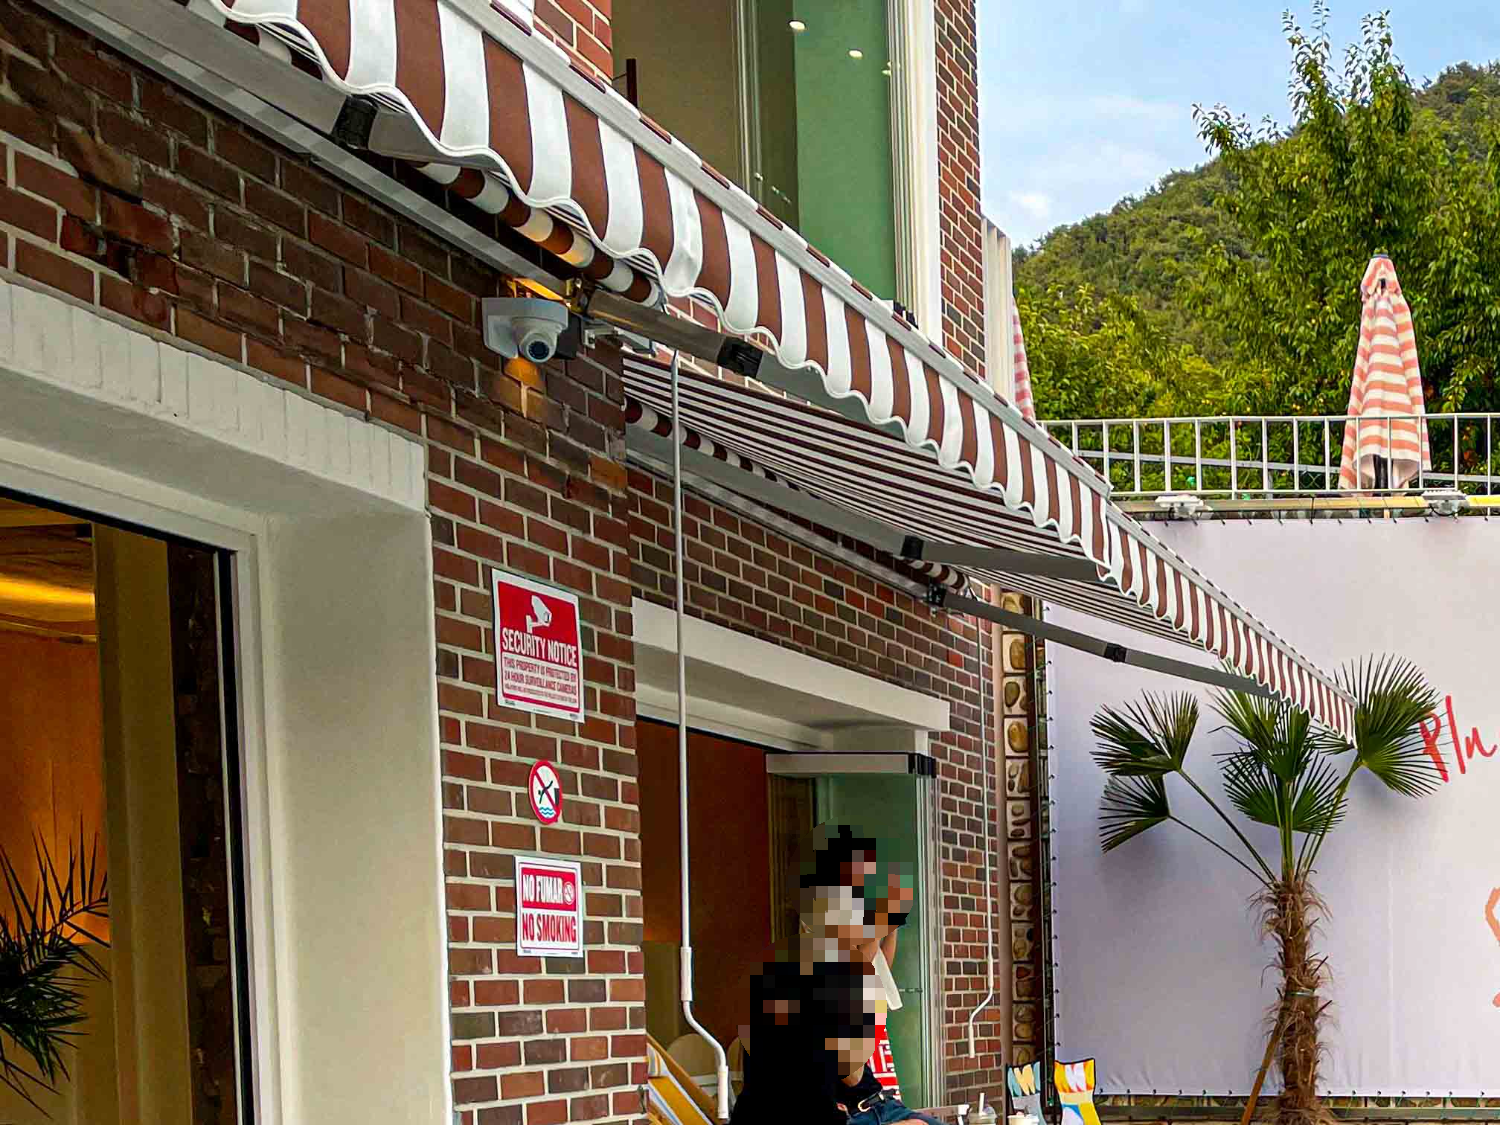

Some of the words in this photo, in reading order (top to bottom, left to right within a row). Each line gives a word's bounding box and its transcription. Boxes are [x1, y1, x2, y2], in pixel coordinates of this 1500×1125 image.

[502, 627, 546, 659] SECURITY
[547, 639, 577, 667] NOTICE
[511, 673, 524, 684] HOUR
[522, 874, 535, 902] NO
[535, 875, 563, 904] FUMAR
[522, 913, 534, 941] NO
[536, 914, 577, 942] SMOKING
